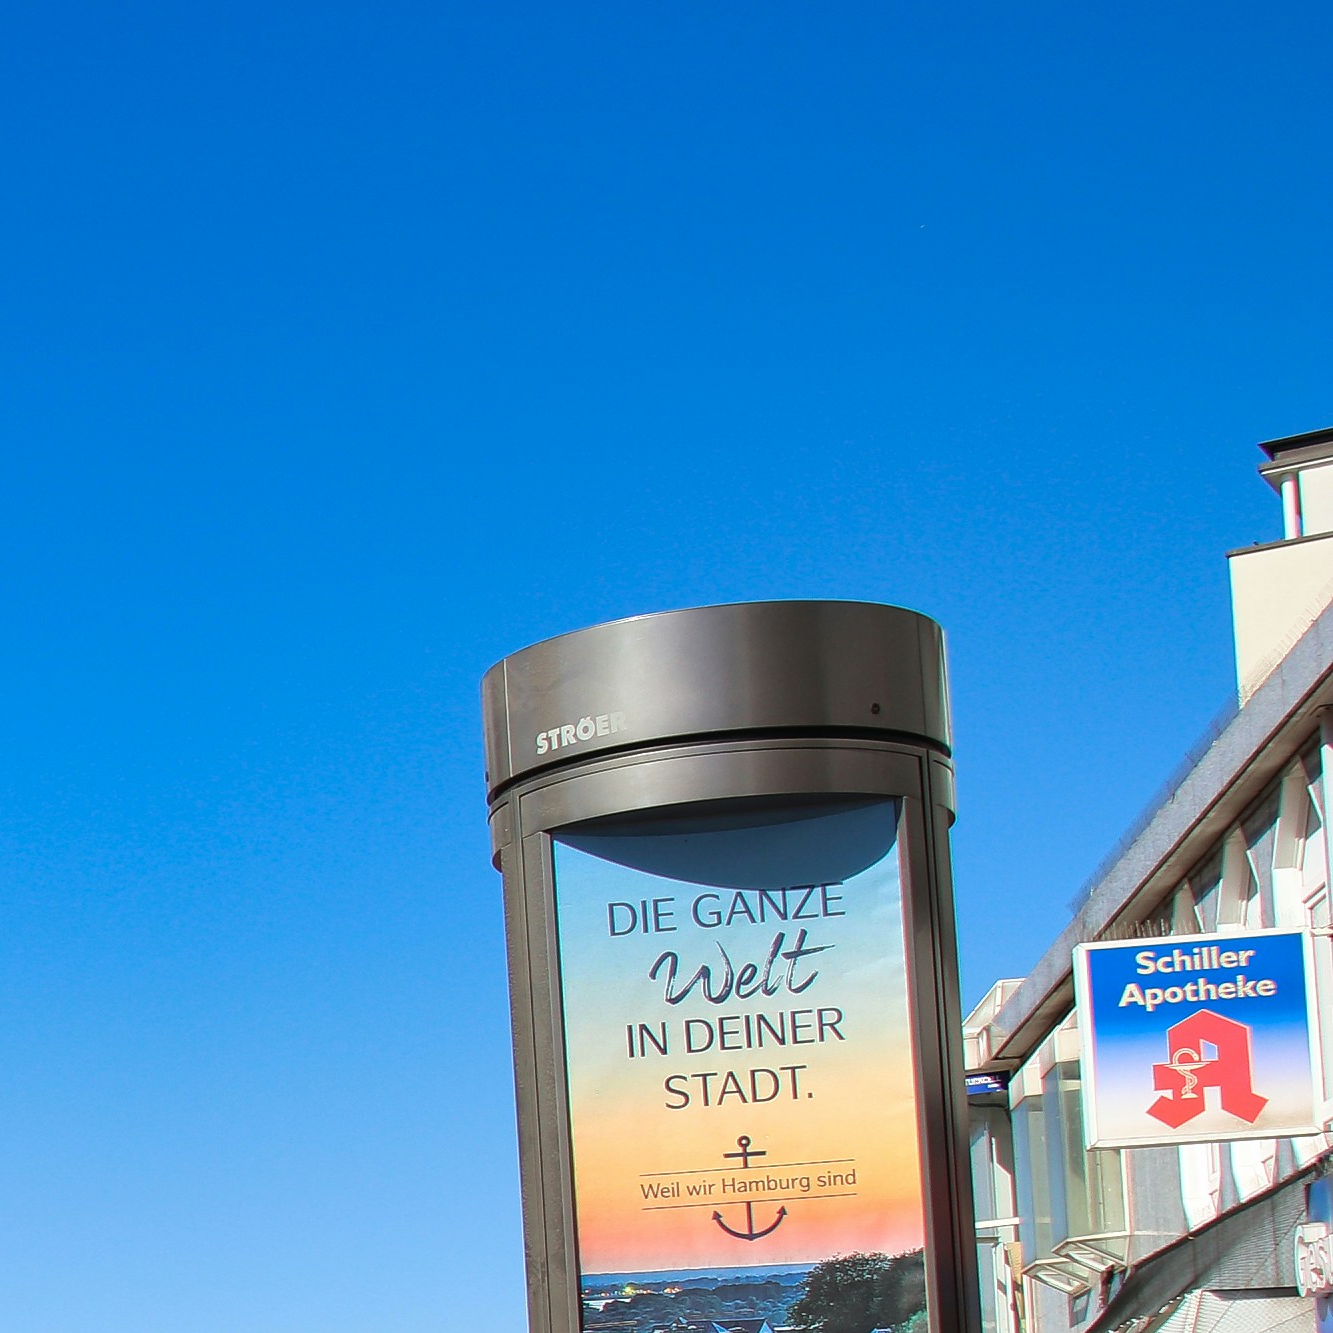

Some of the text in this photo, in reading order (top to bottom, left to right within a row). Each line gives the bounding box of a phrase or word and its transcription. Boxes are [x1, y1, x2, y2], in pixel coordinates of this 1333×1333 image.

[536, 711, 628, 755] STRÖER
[607, 881, 846, 936] DIE GANZE
[648, 928, 835, 1005] Welt
[1135, 945, 1256, 975] Schiller
[1118, 975, 1278, 1012] Apotheke
[626, 1007, 846, 1058] IN DEINER
[664, 1065, 813, 1110] STADT.
[640, 1168, 856, 1199] Weil wir Hamburg sind
